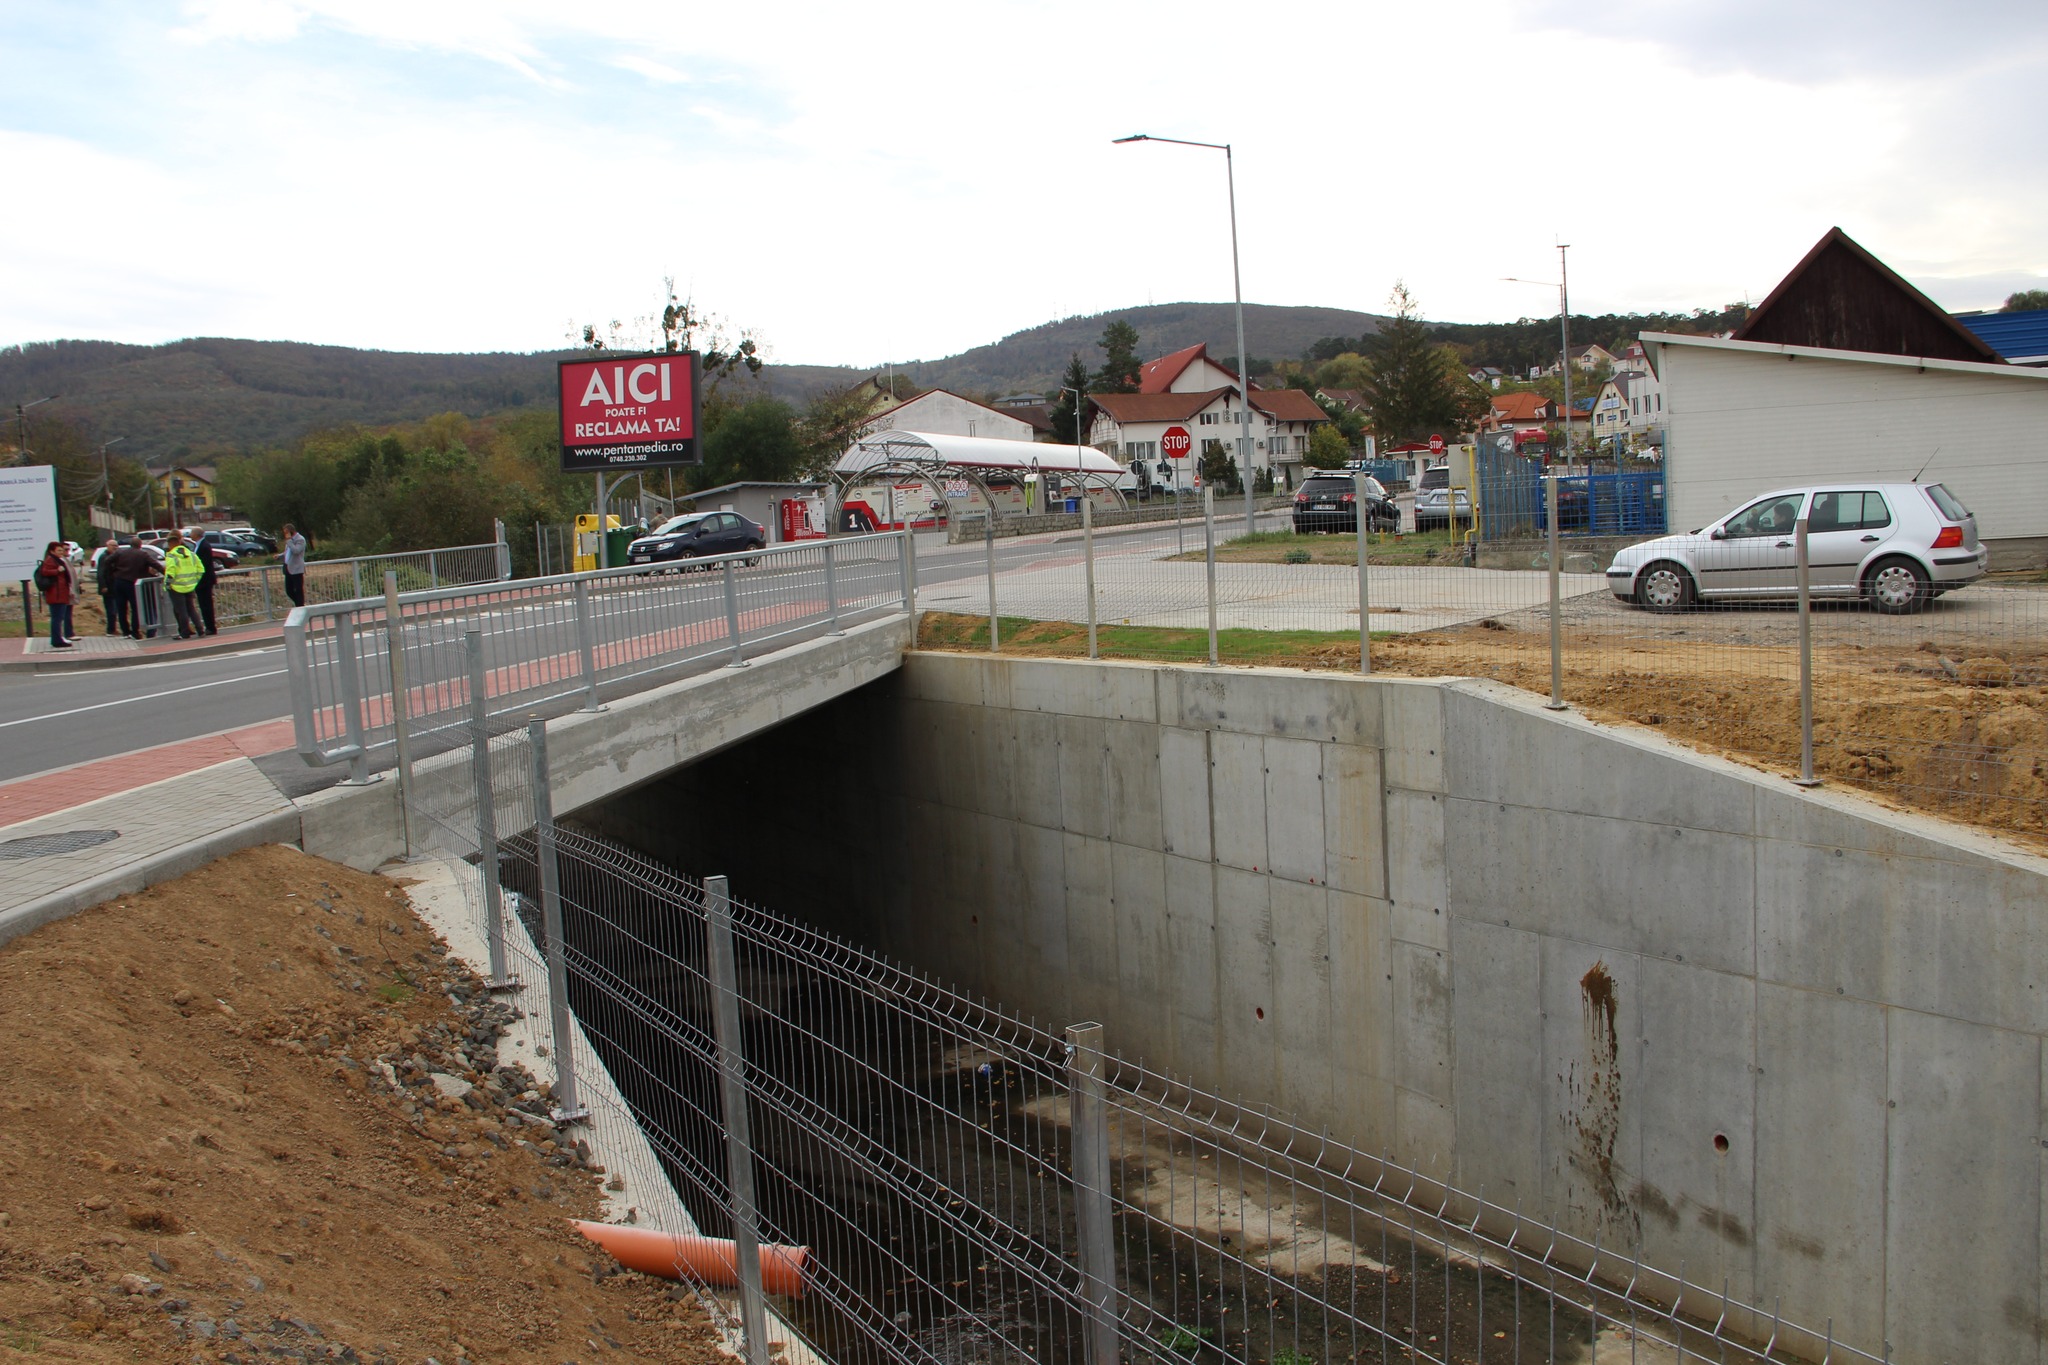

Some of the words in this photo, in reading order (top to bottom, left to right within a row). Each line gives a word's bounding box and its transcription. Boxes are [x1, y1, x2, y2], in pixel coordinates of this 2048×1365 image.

[580, 363, 671, 406] AICI
[605, 407, 635, 418] POATE
[638, 406, 647, 416] FI
[575, 420, 651, 437] RECLAMA
[654, 417, 681, 433] TA!
[574, 441, 684, 458] www.pentamedia.ro
[1163, 435, 1189, 449] STOP
[1429, 440, 1443, 450] STOP
[609, 454, 647, 463] 0748.230.302
[848, 513, 859, 529] 1
